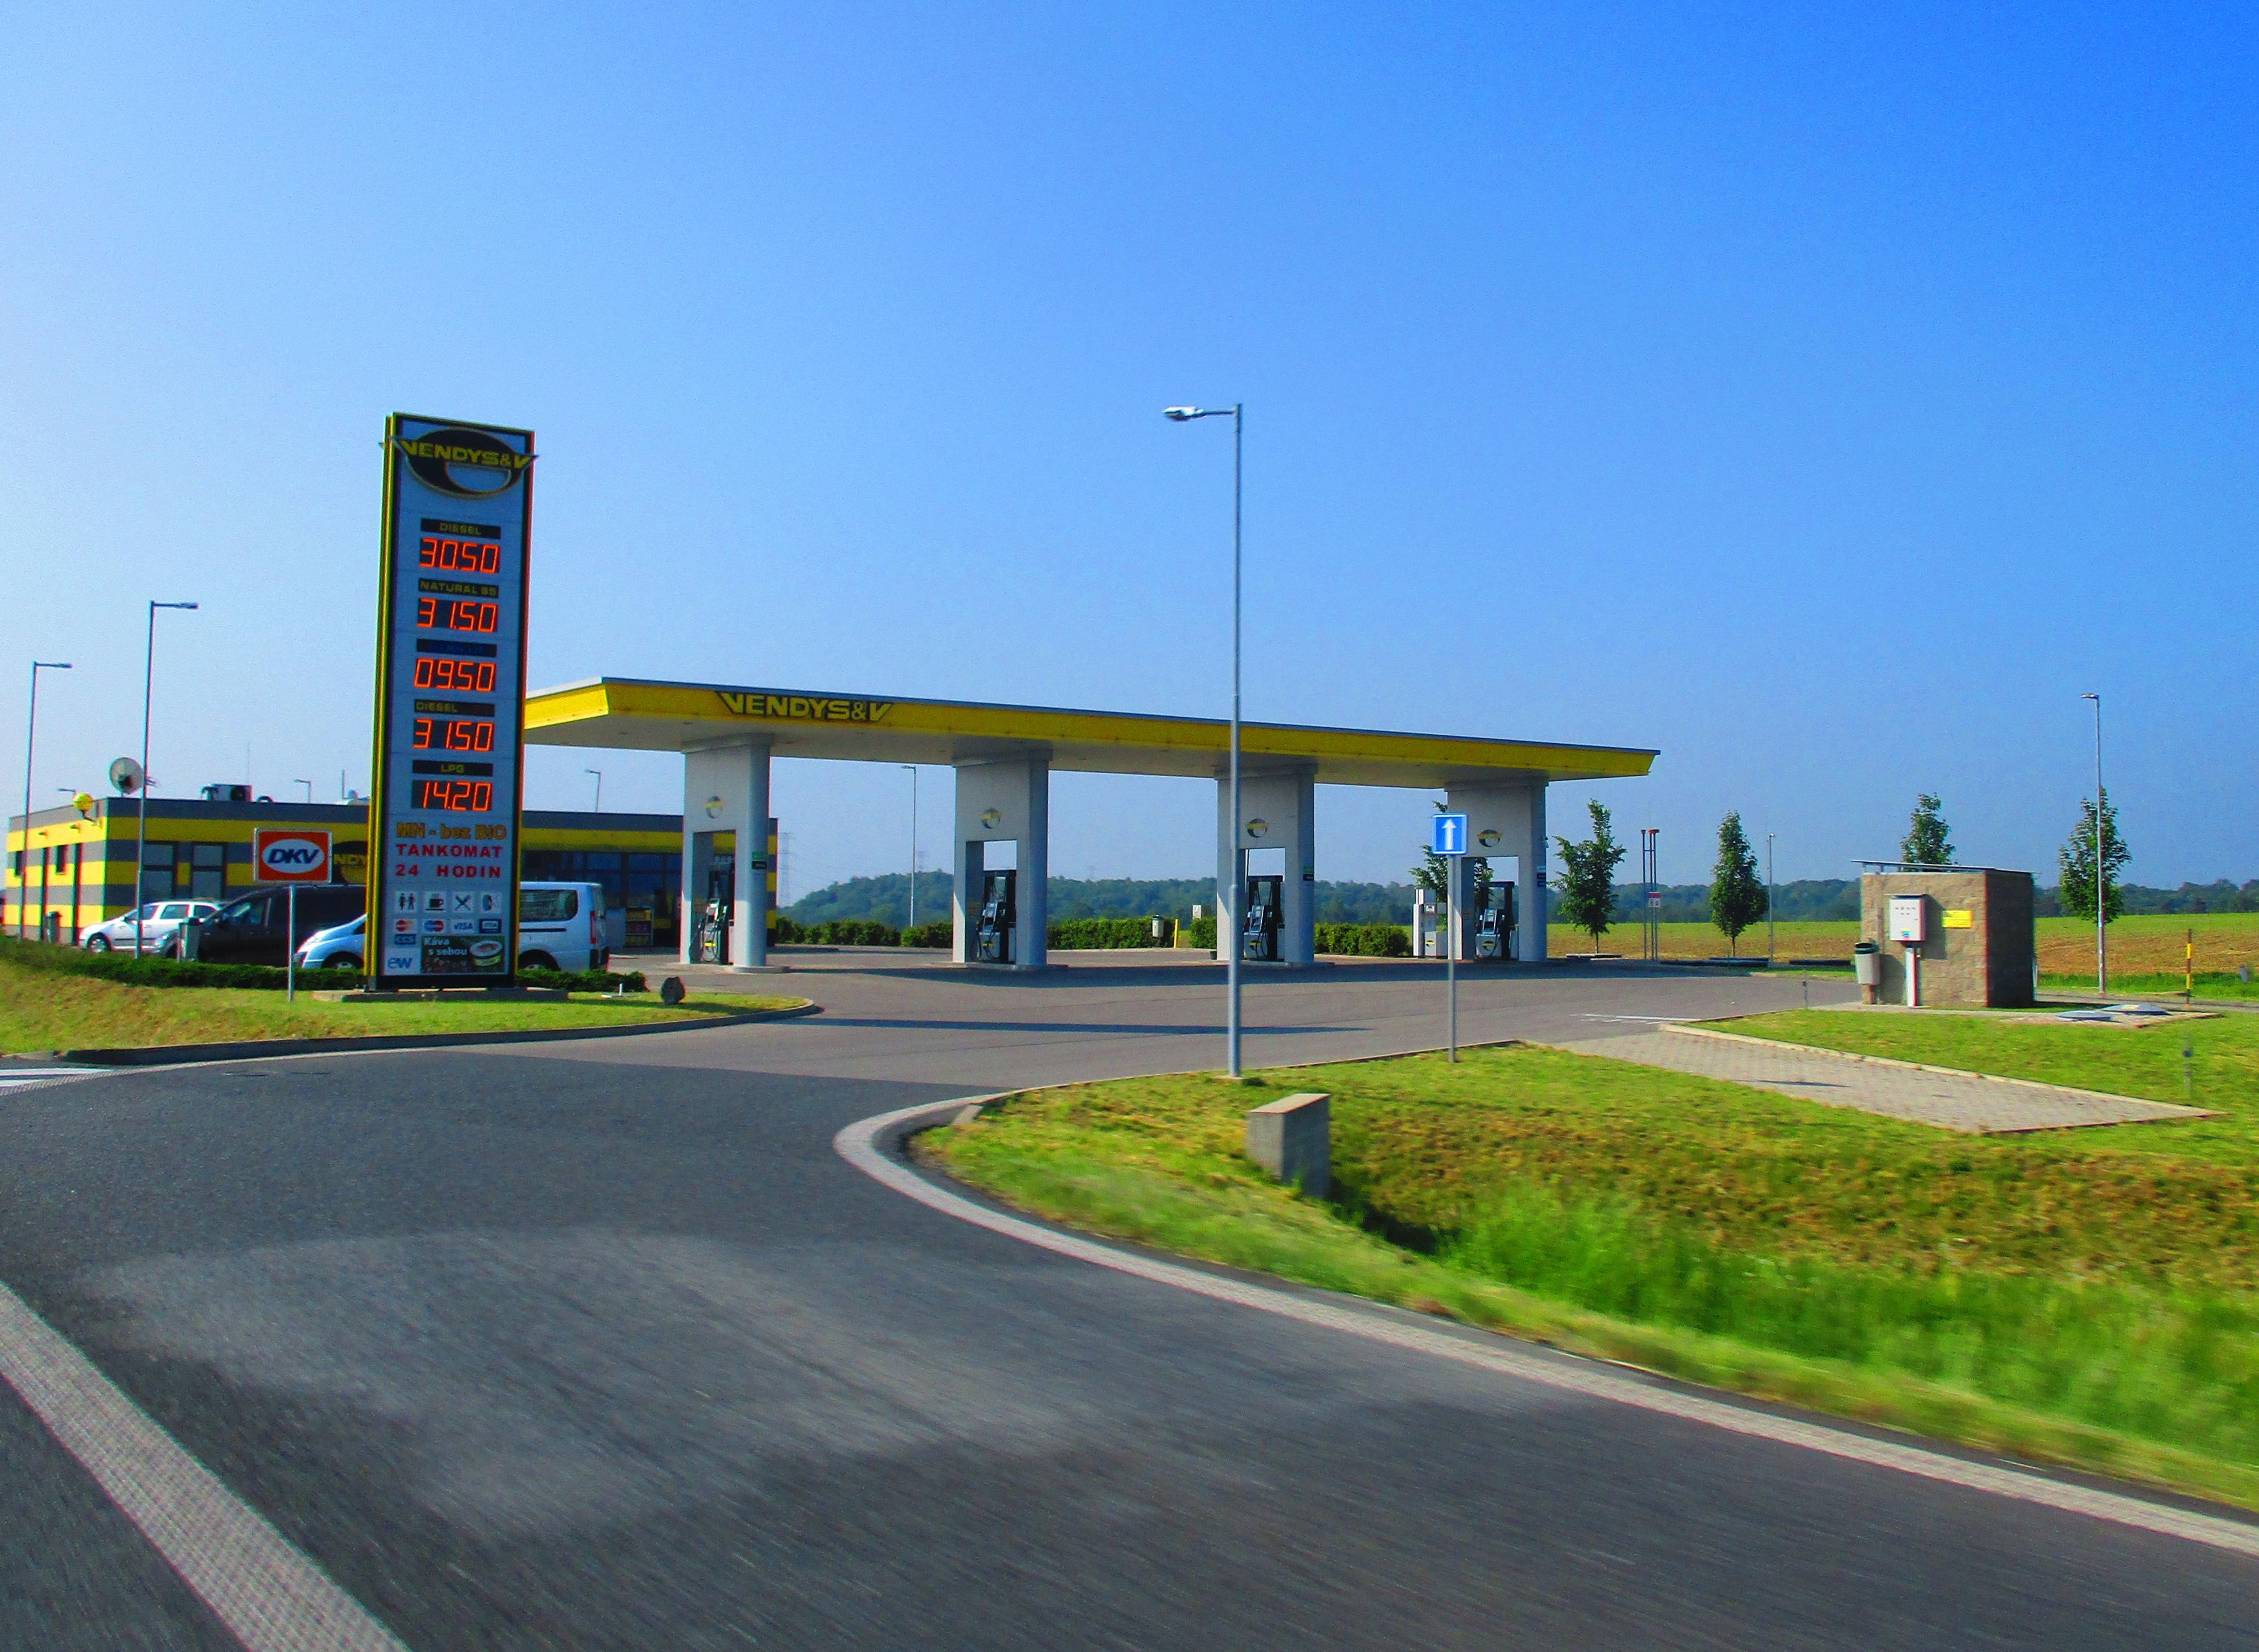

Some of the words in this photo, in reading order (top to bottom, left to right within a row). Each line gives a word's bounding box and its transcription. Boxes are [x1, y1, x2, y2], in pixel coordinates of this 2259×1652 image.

[399, 439, 530, 469] VENDYS&V
[439, 522, 481, 535] DIESEL
[420, 581, 477, 594] NATURAL
[416, 702, 458, 713] DIESEL
[721, 692, 892, 722] VENDYS&V
[441, 764, 465, 774] LPG
[440, 823, 471, 839] bez
[475, 824, 507, 840] BIO
[267, 848, 320, 864] DKV
[395, 843, 504, 858] TANKOMAT
[395, 864, 419, 876] 24
[437, 865, 501, 878] HODIN
[437, 946, 468, 956] sebou
